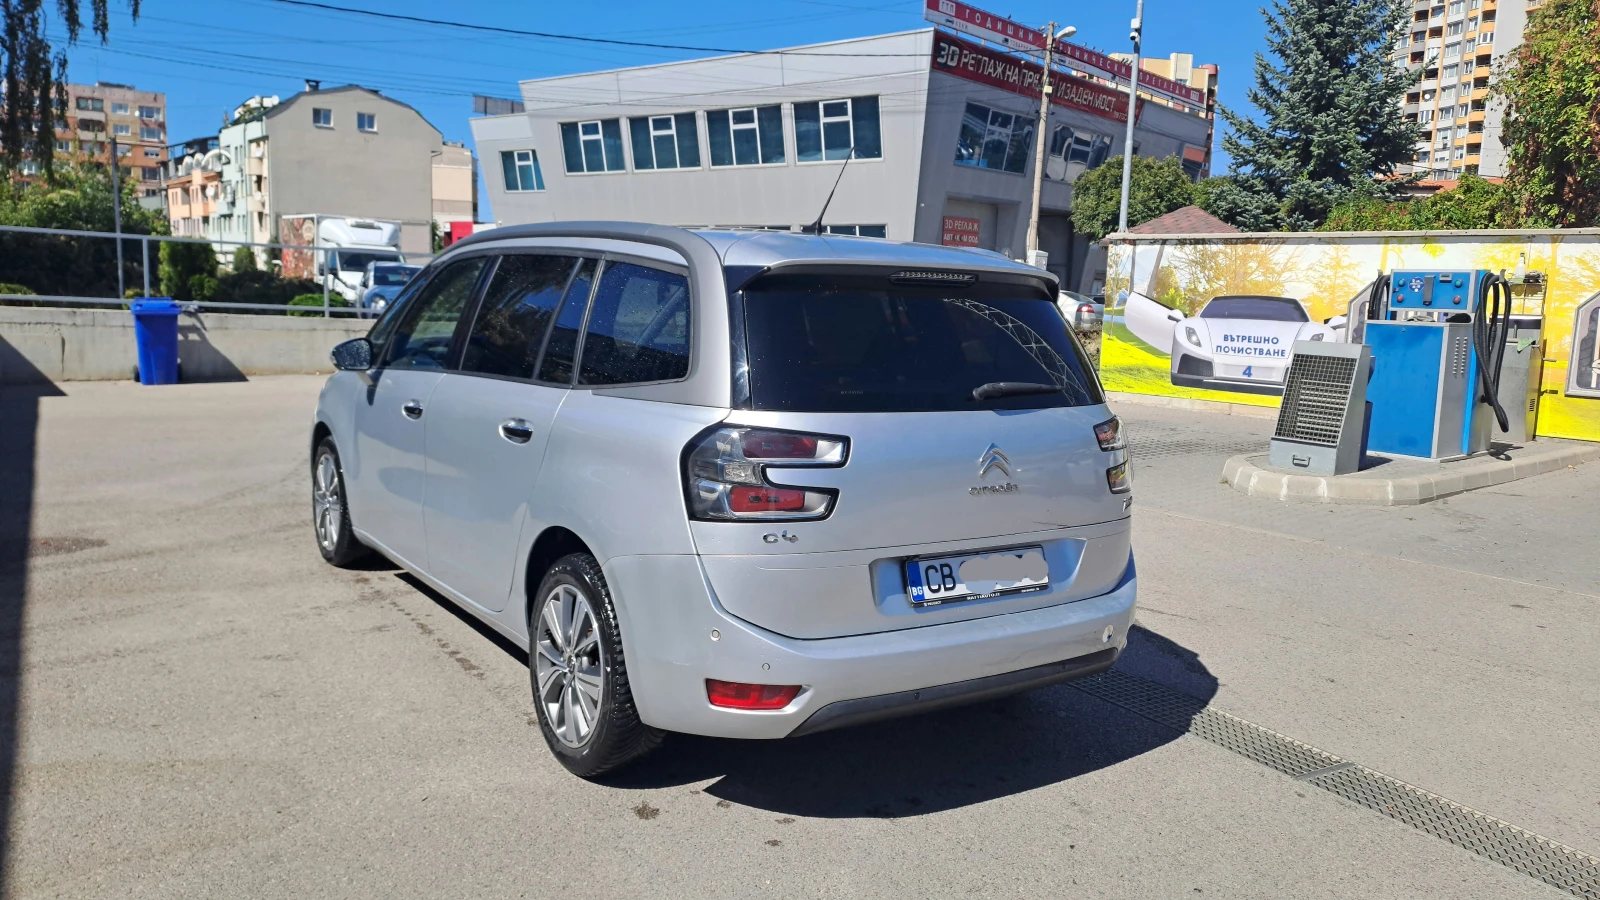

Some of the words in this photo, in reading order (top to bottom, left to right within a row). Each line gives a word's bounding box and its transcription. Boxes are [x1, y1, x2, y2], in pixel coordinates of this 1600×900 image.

[965, 9, 1034, 41] ГОДИШНИ
[936, 42, 960, 67] 3D
[960, 50, 1005, 80] РЕГЛАЖ
[1005, 65, 1019, 85] НА
[944, 219, 953, 229] 3D
[954, 220, 979, 232] РЕГЛАЖ
[1223, 334, 1279, 345] ВЪТРЕШНО
[1215, 345, 1286, 357] ПОЧИСТВАНЕ
[1242, 365, 1253, 378] 4
[762, 529, 799, 544] C4
[912, 586, 923, 597] BG
